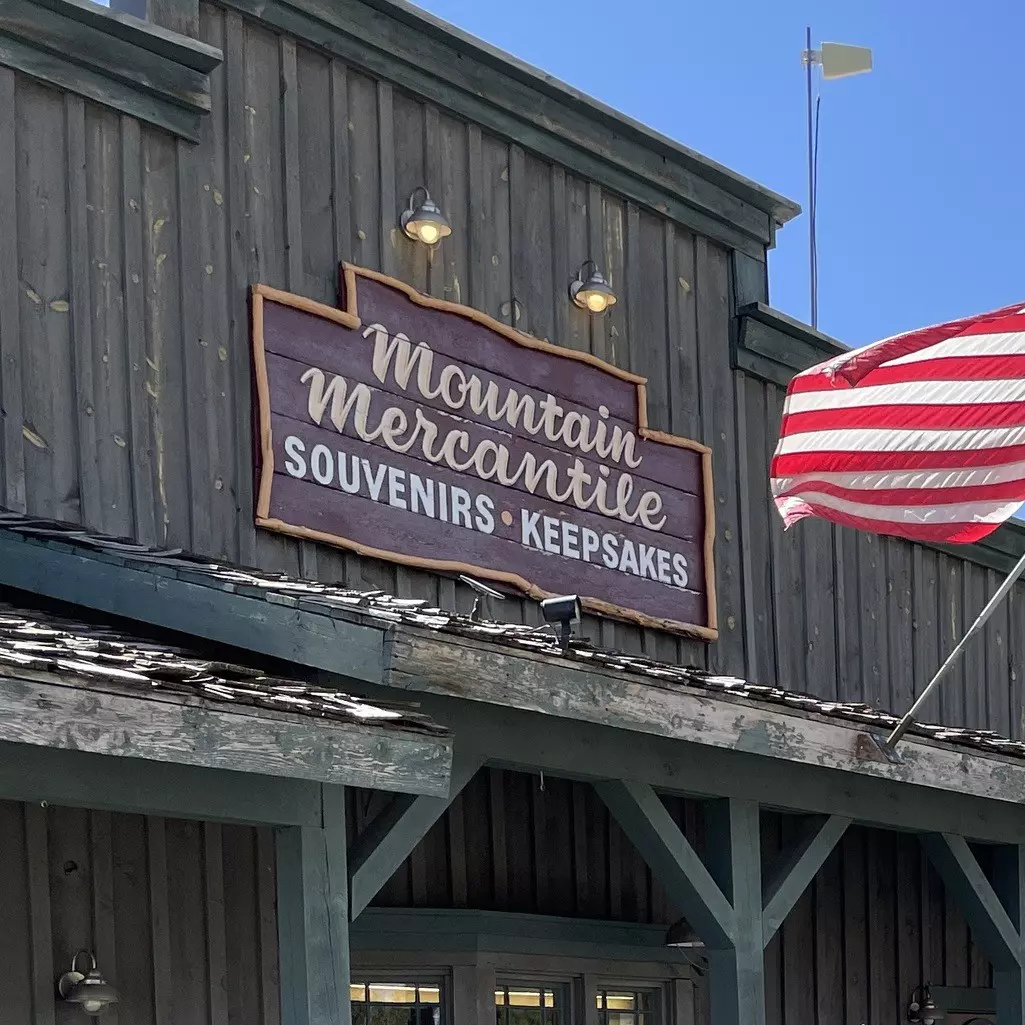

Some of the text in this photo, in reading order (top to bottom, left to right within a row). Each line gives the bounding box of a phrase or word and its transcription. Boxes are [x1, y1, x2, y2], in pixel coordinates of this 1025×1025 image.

[300, 367, 667, 531] Mercantile
[362, 323, 642, 469] Mountain
[284, 435, 688, 588] SOUVENIRS KEEPSAKES
